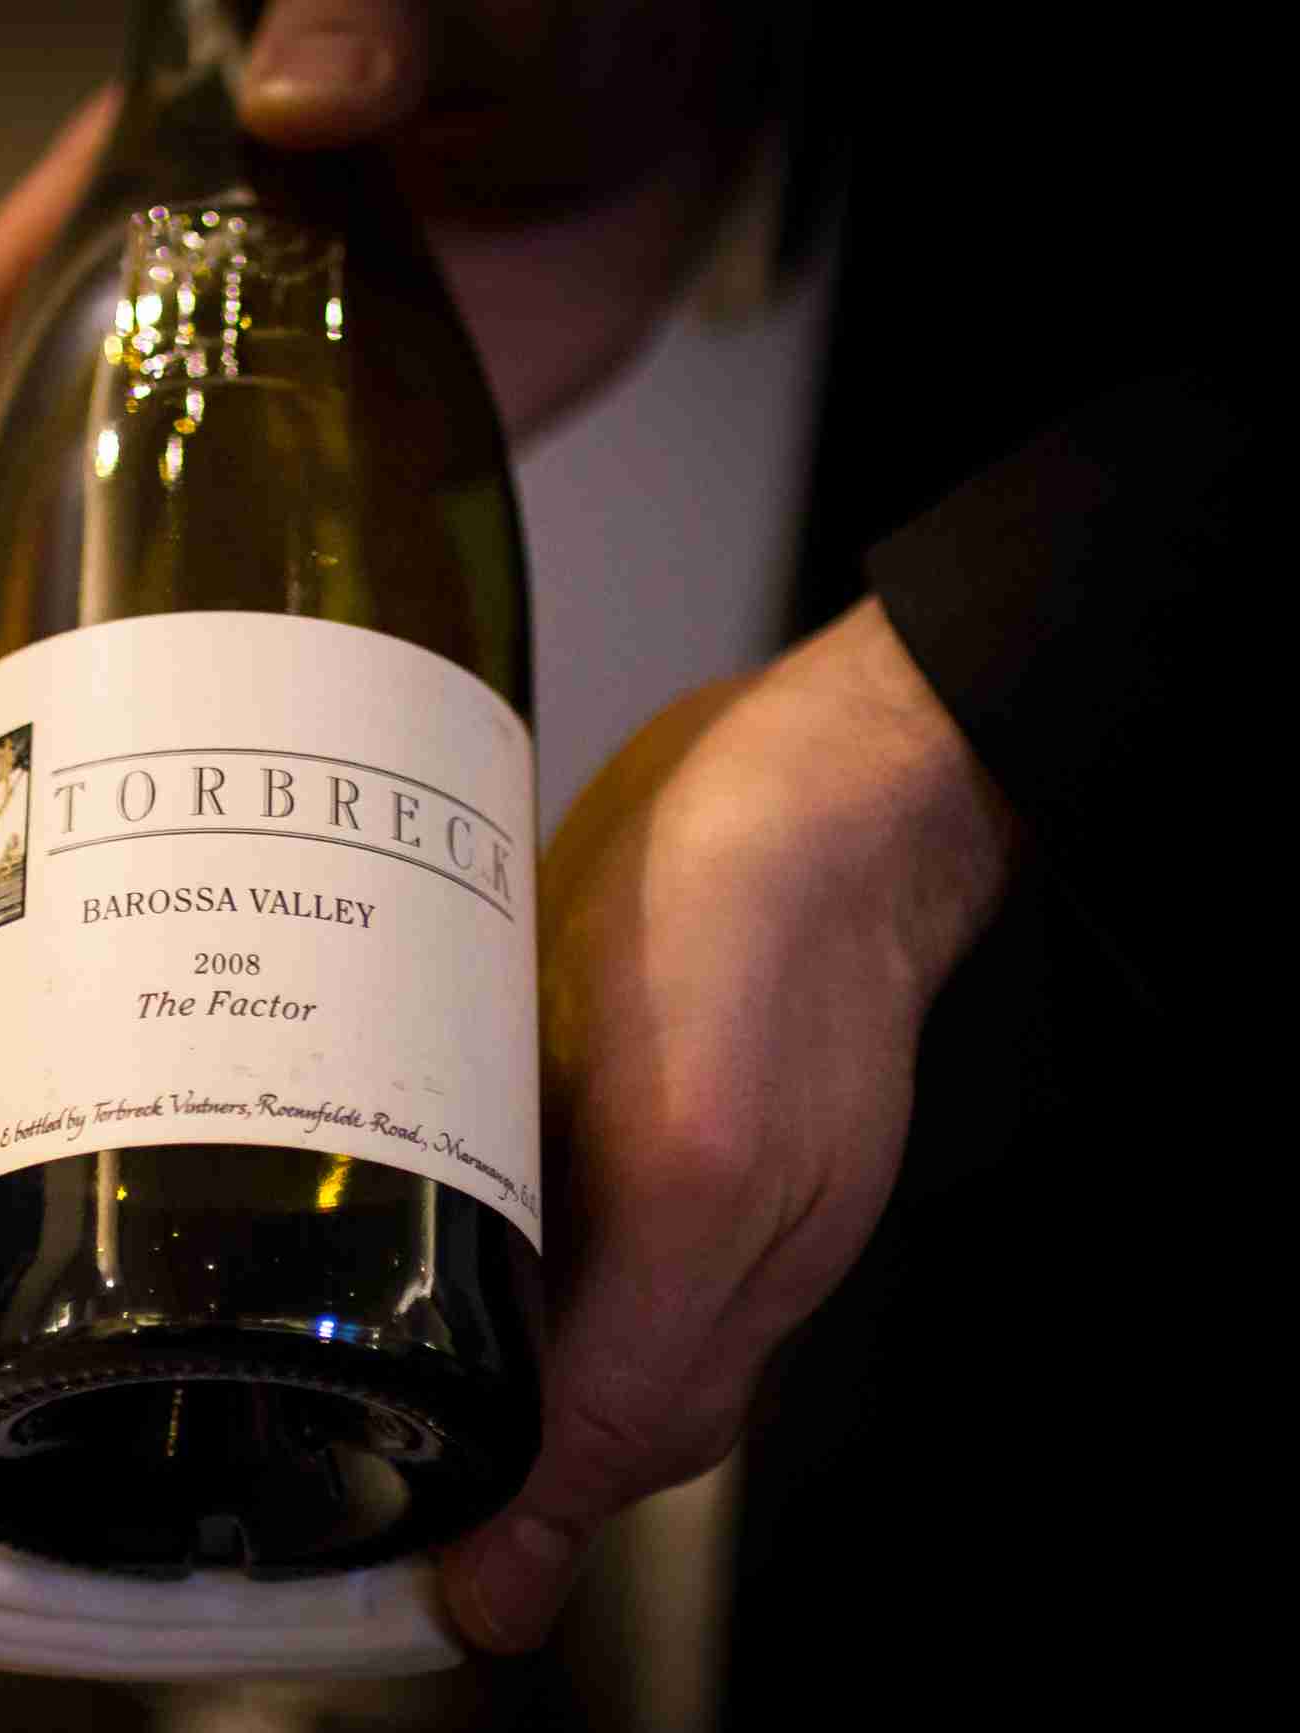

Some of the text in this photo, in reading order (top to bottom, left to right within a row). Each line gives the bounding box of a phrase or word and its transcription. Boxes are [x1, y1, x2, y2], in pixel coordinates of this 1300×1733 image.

[54, 765, 514, 906] TORBRECK
[81, 887, 376, 929] BAROSSA VALLEY
[193, 952, 262, 977] 2008
[138, 990, 318, 1021] The Factor
[13, 1107, 68, 1143] bottled
[67, 1106, 86, 1142] by
[92, 1095, 164, 1125] Torbreck
[168, 1089, 253, 1120] Vintners,
[368, 1111, 428, 1152] Road,
